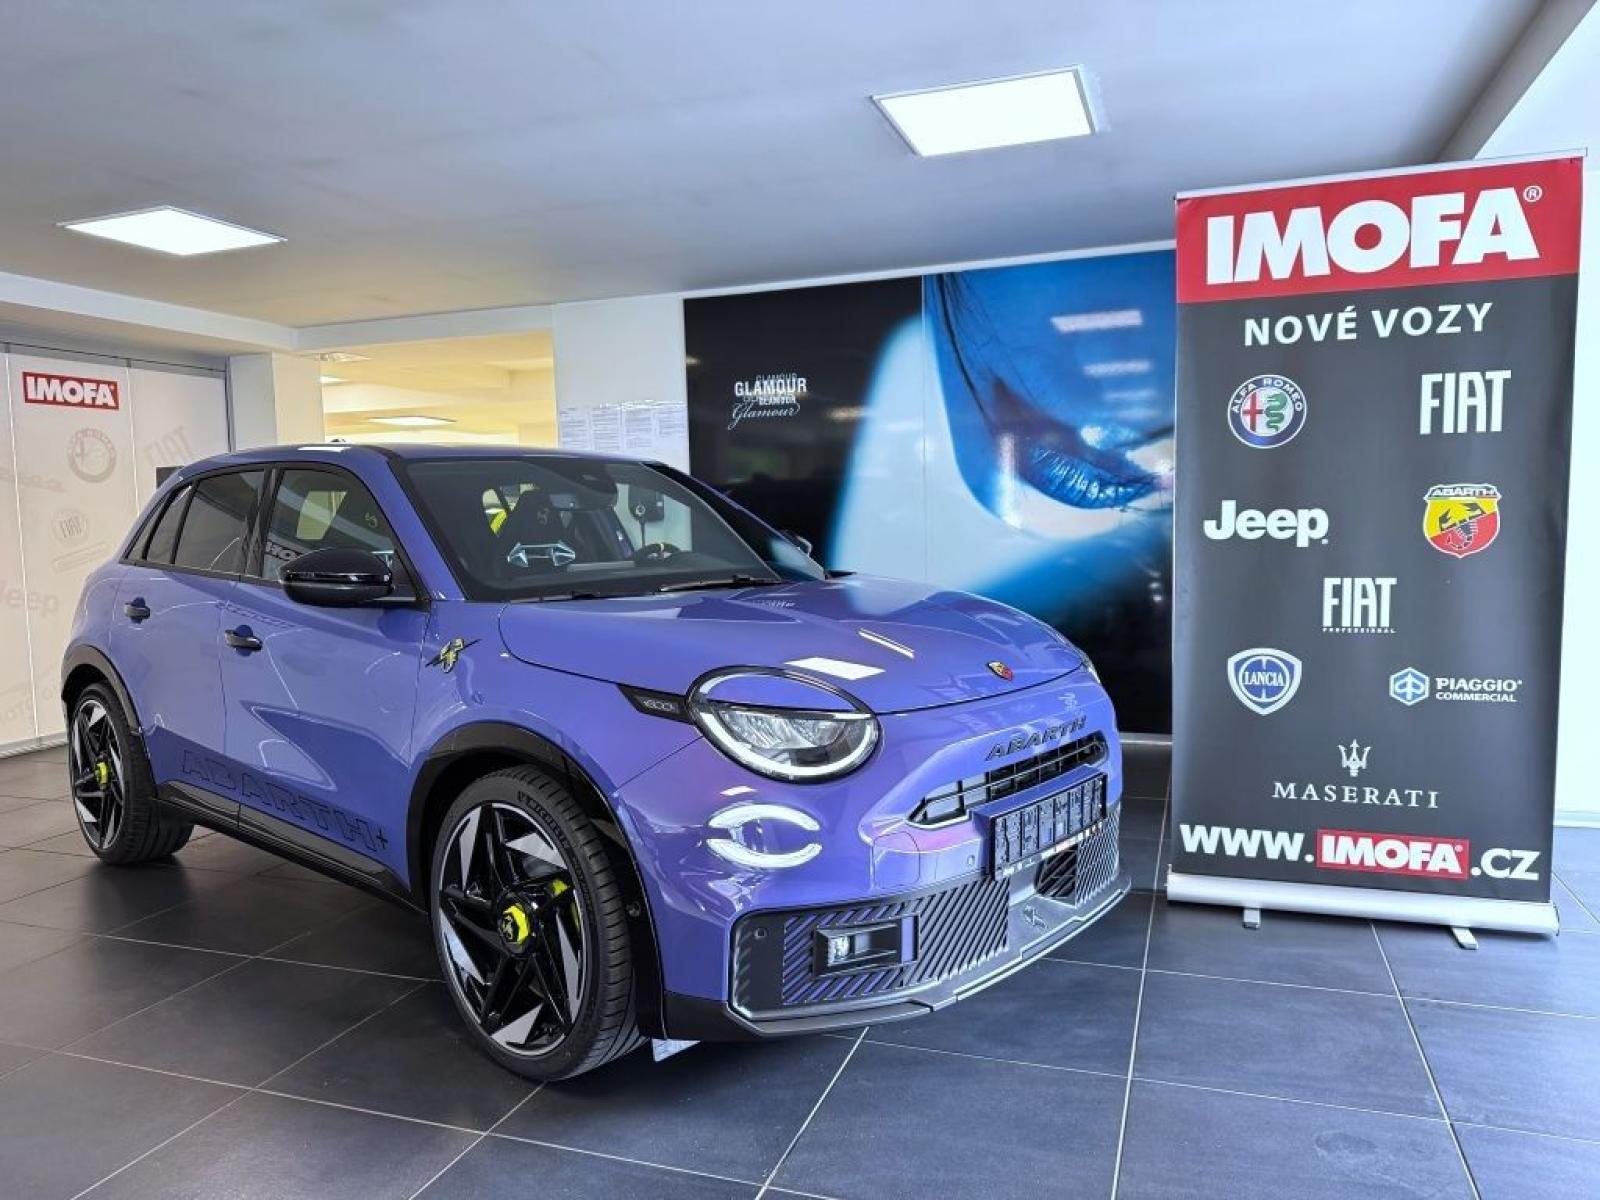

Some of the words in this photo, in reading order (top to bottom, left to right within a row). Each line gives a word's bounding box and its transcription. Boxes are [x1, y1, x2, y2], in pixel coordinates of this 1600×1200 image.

[1244, 306, 1358, 347] NOVÉ
[1371, 302, 1494, 339] VOZY
[25, 376, 116, 407] IMOFA
[735, 378, 807, 396] GLAMOUR
[1231, 383, 1257, 413] ALFA
[1263, 377, 1303, 412] ROMEO
[1420, 369, 1512, 436] FIAT
[728, 401, 801, 431] Glamour
[1432, 487, 1497, 497] ABARTH
[1203, 500, 1329, 547] Jeep
[1322, 577, 1398, 627] FIAT
[1244, 671, 1284, 687] LANCIA
[1435, 691, 1518, 703] COMMERCIAL
[984, 715, 1087, 762] ABARTH
[1271, 781, 1440, 810] MASERATI
